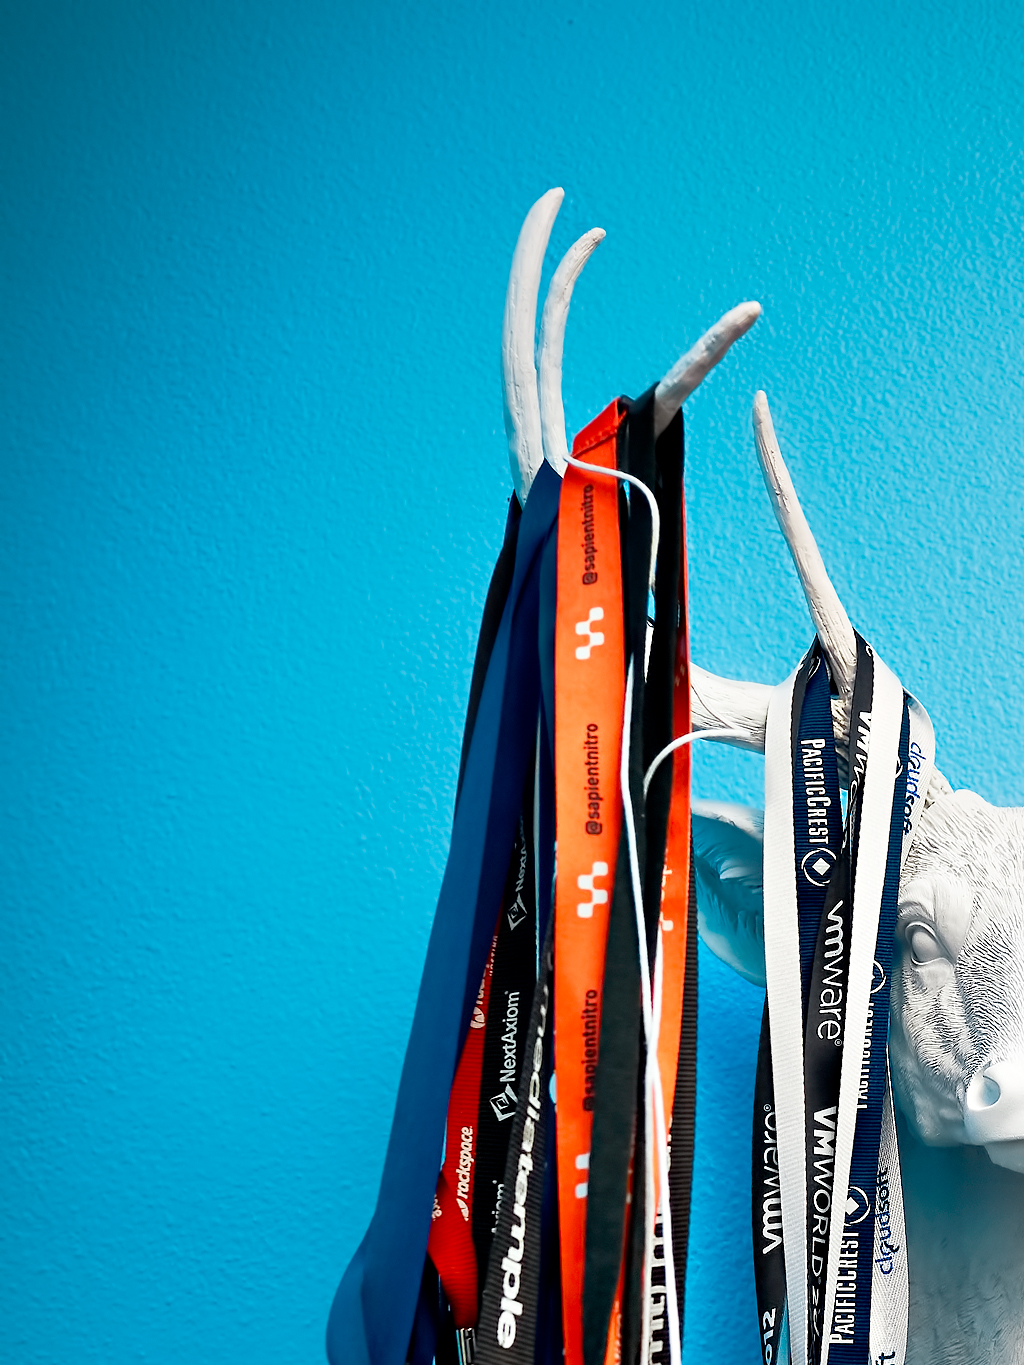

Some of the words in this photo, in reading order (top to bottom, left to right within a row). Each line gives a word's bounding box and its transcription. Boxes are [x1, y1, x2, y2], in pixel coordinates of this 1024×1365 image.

[583, 723, 603, 835] @sapientnitro
[817, 900, 844, 1042] vmware
[500, 991, 520, 1082] NextAxiom
[456, 1125, 474, 1200] rackspace
